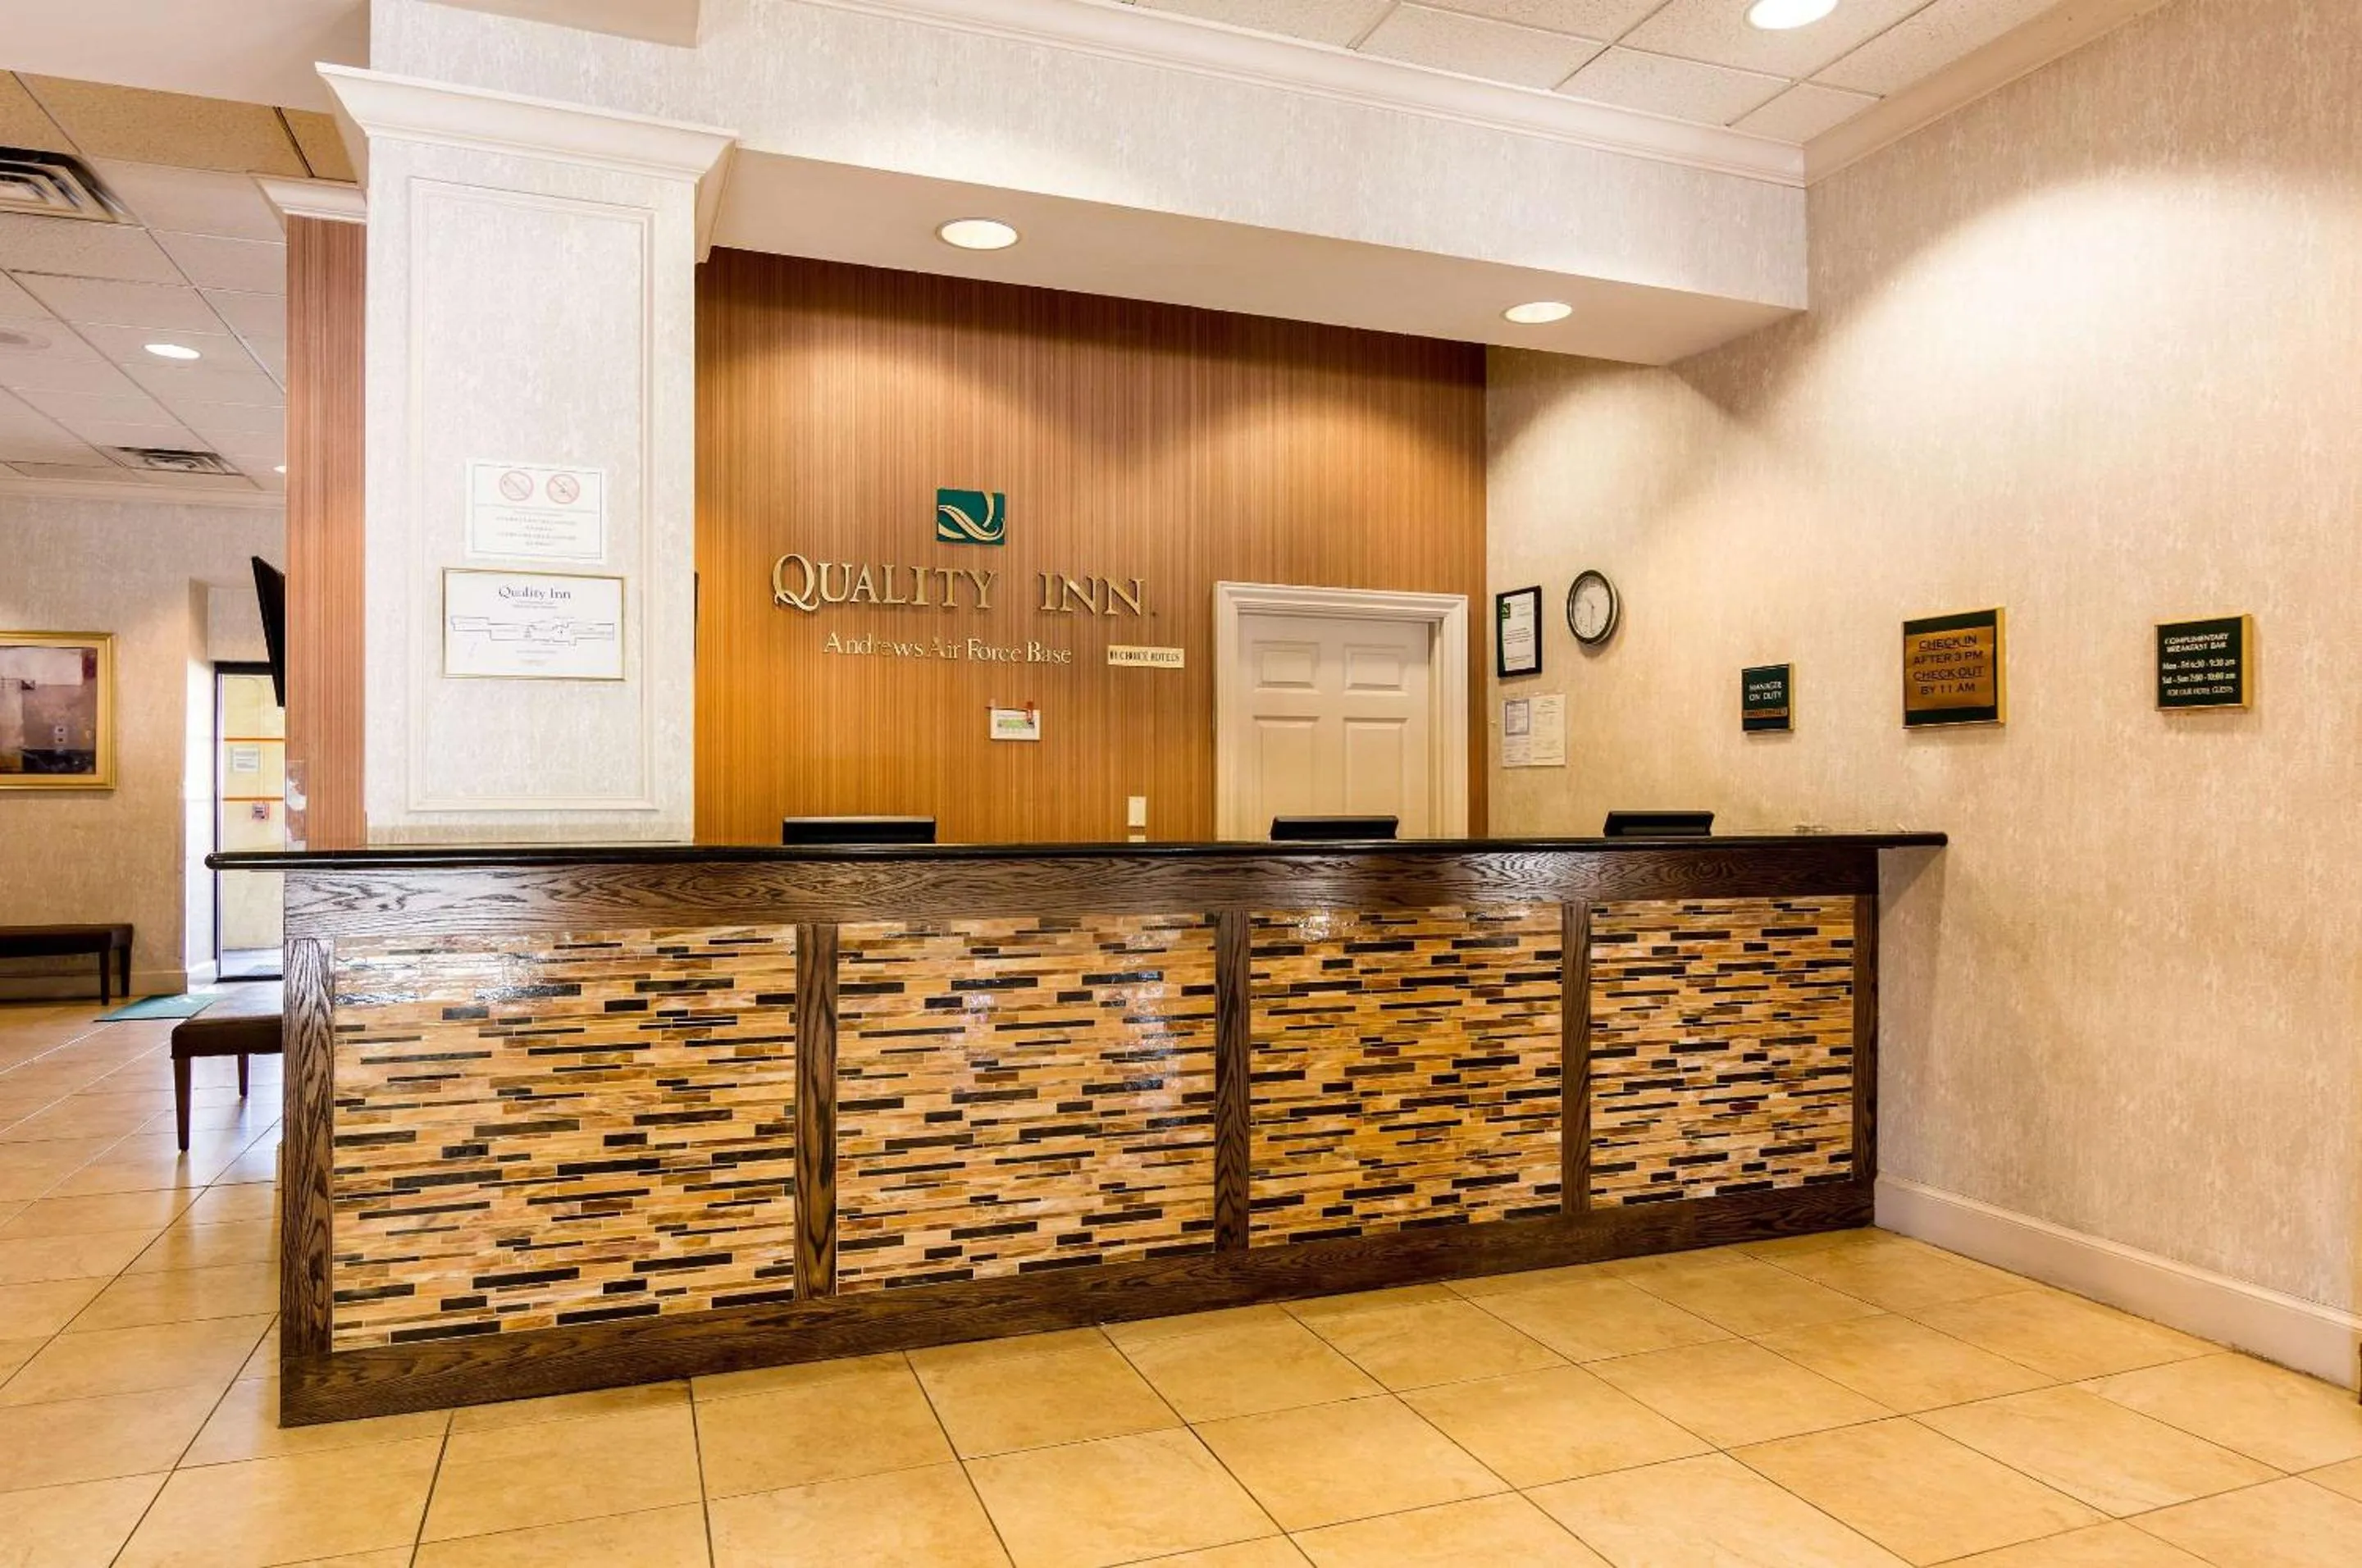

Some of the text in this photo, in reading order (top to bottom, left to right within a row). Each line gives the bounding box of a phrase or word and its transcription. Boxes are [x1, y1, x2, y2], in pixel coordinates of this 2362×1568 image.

[499, 584, 571, 599] Quality Inn
[773, 554, 1145, 616] QUALITY INN
[823, 631, 1072, 664] Andrews Air Force Base
[1919, 635, 1977, 651] CHECK IN
[1913, 651, 1983, 665] AFTER 3 PM
[1913, 666, 1984, 682] CHECK OUT
[1749, 691, 1782, 701] ON DUTY
[1921, 685, 1935, 695] BY
[1957, 682, 1976, 693] AM
